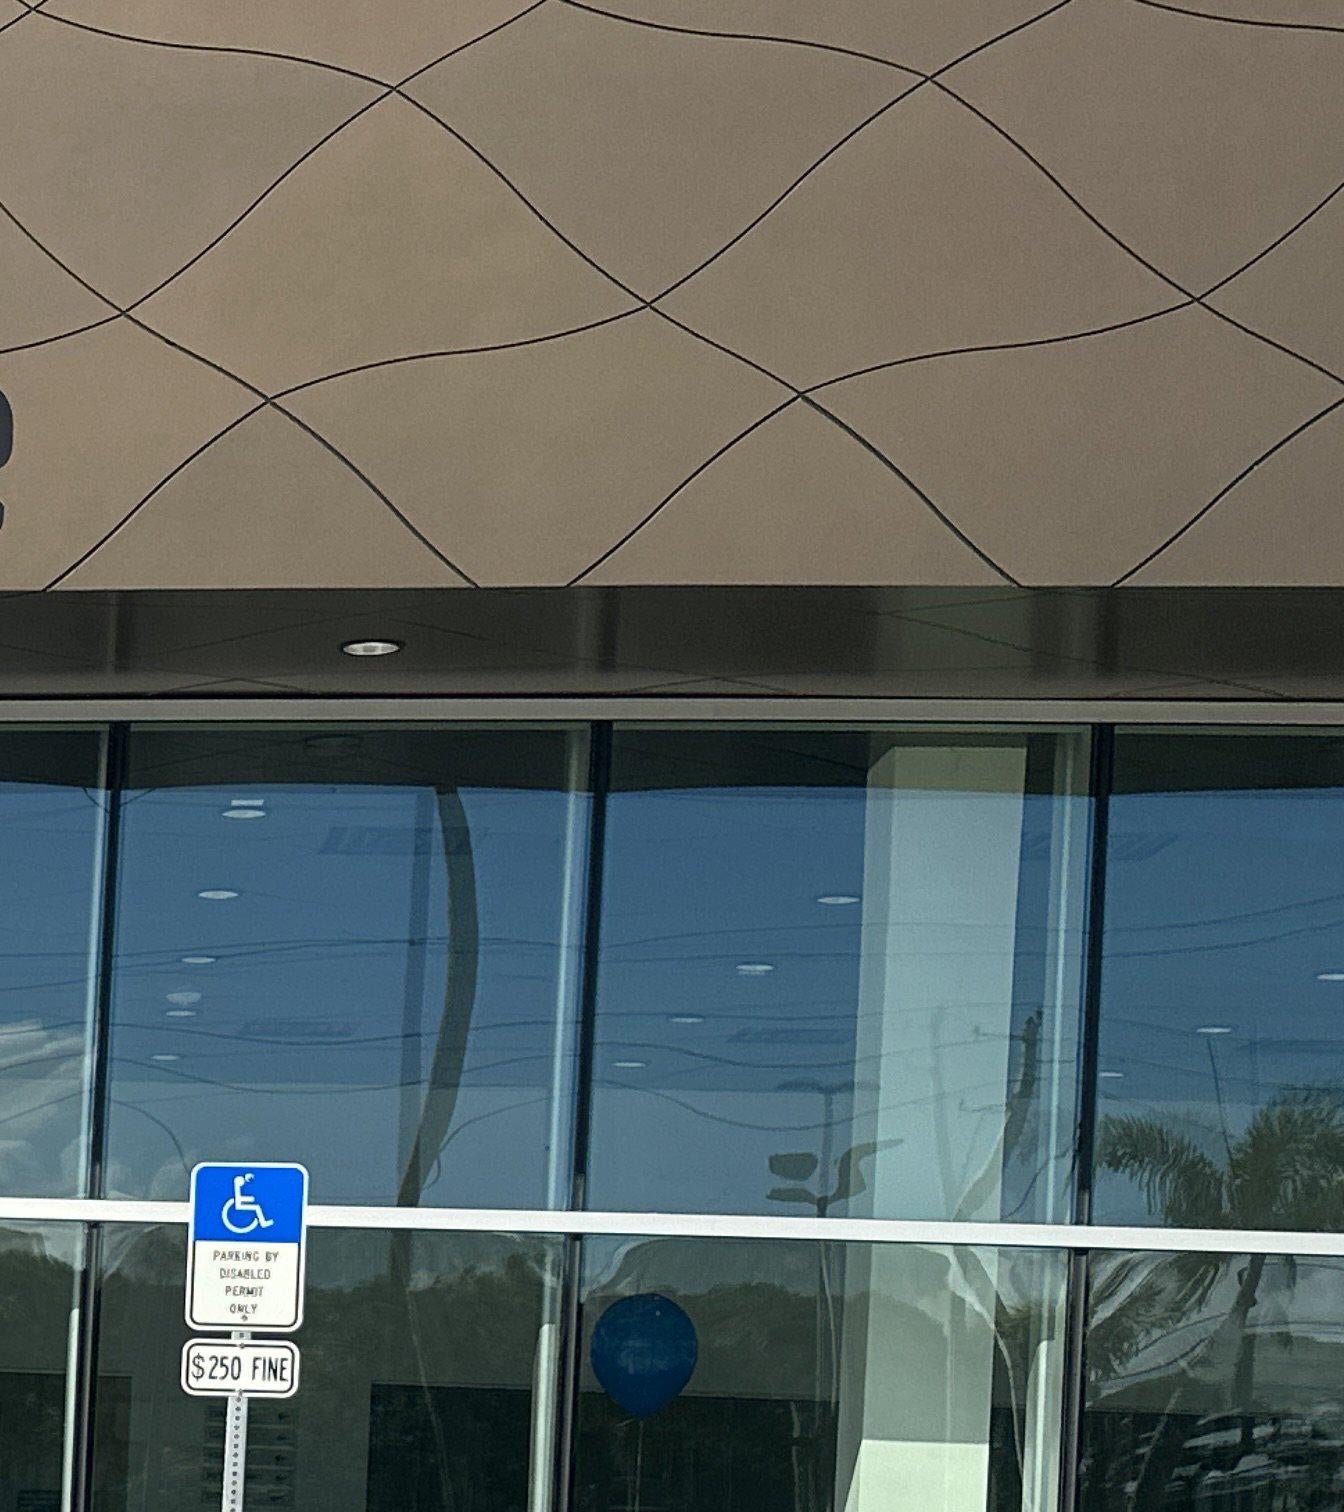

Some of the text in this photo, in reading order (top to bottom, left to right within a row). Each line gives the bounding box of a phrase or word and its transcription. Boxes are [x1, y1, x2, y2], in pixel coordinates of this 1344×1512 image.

[213, 1250, 279, 1263] PARKING BY
[219, 1268, 271, 1280] DISABLED
[225, 1286, 264, 1297] PERMIT
[229, 1303, 258, 1314] ONLY
[191, 1352, 289, 1382] $250 FINE
